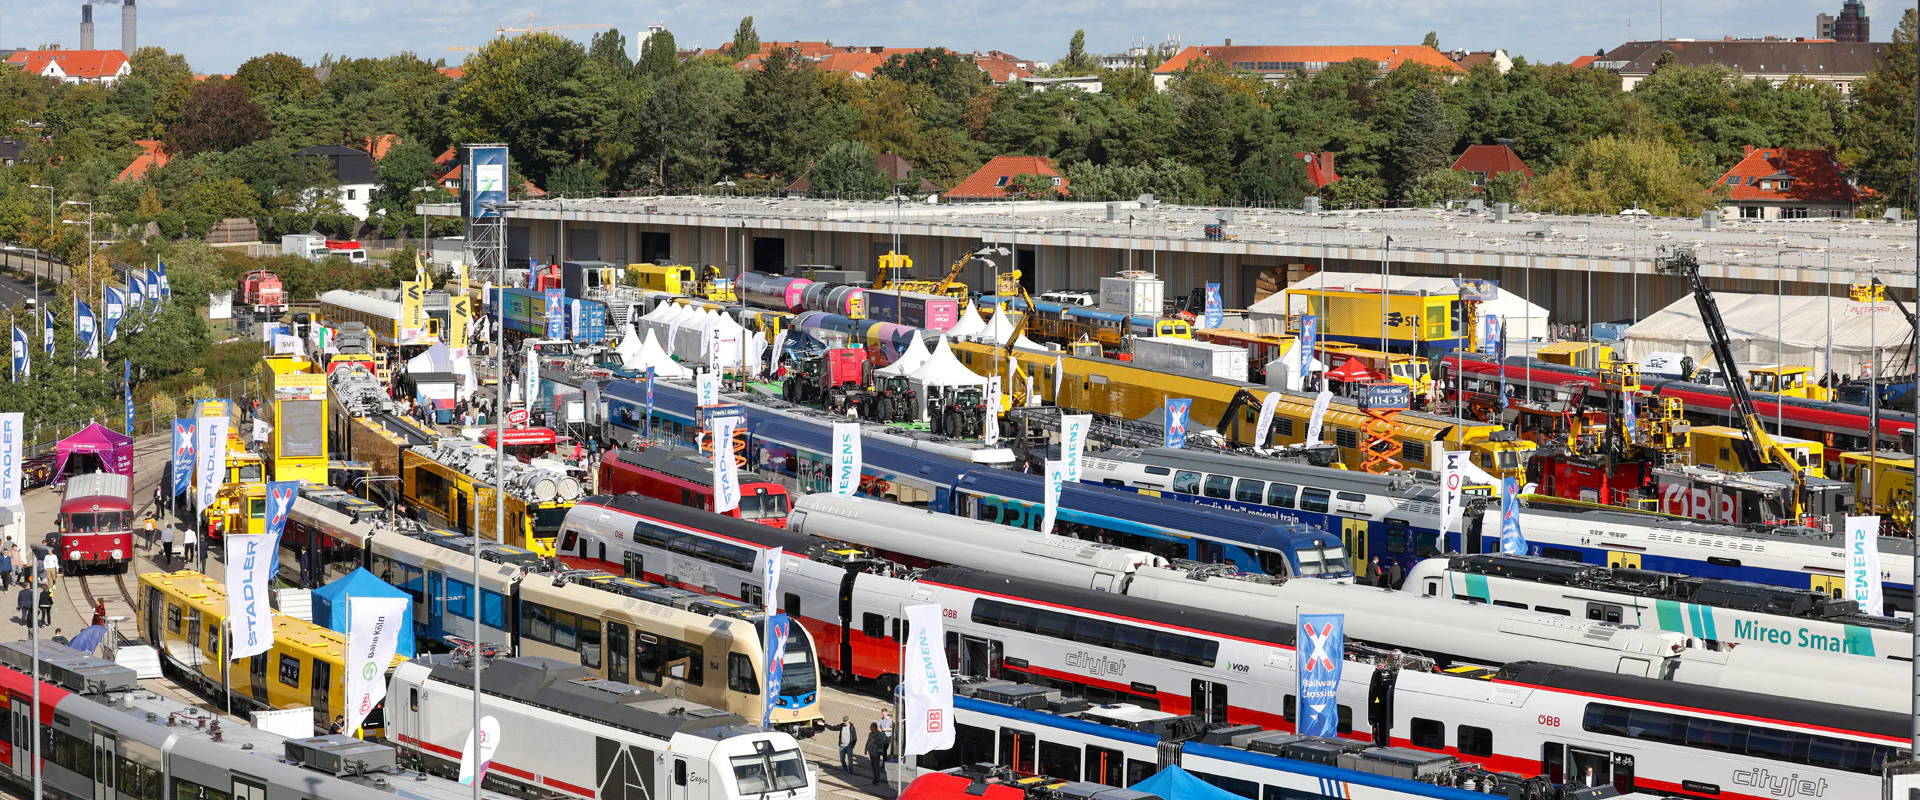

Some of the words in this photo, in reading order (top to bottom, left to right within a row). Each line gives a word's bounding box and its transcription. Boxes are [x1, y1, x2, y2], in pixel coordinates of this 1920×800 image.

[2, 420, 12, 500] STADLER
[204, 424, 218, 506] STADLER
[838, 433, 852, 495] IEMENS
[1069, 422, 1080, 482] IEMENS
[242, 540, 259, 647] STADLER
[373, 615, 385, 638] Köln
[942, 607, 958, 620] ÖBB
[1733, 618, 1793, 646] Mireo
[1797, 627, 1860, 655] Smart
[918, 626, 939, 694] SIEMENS
[1065, 650, 1127, 677] cityjet
[1232, 662, 1250, 674] VOR
[1302, 678, 1337, 689] Railway
[928, 711, 941, 731] DB
[1537, 713, 1561, 727] ÖBB
[1731, 766, 1829, 798] cityjet
